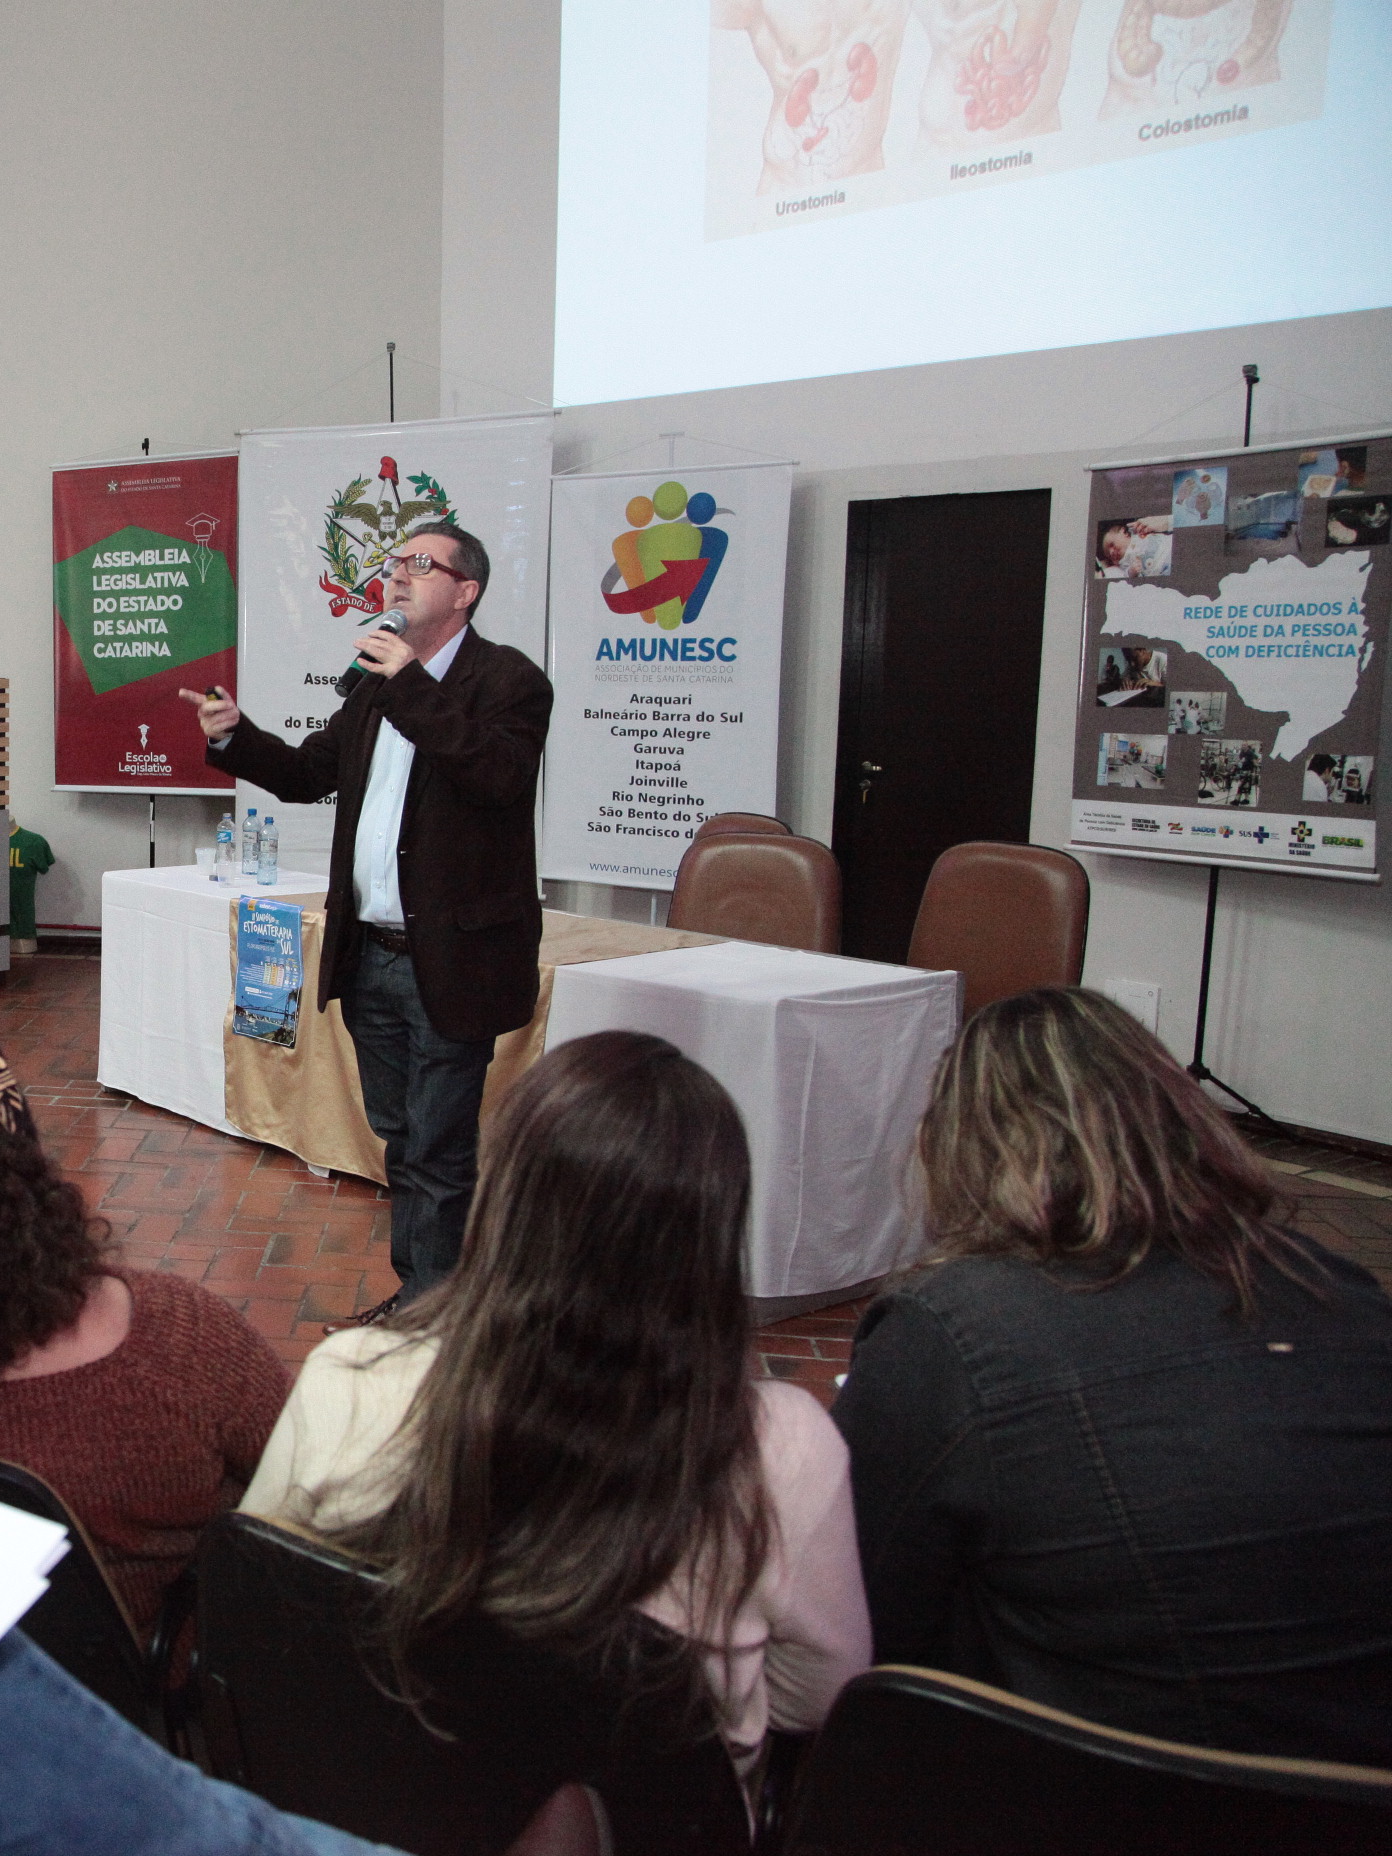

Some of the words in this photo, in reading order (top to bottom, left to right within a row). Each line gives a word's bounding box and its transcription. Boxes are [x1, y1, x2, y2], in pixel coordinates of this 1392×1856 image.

[1138, 104, 1249, 142] Colostomia
[950, 150, 1033, 180] Ileostomia
[775, 190, 846, 216] Urostomia
[92, 548, 191, 568] ASSEMBLEIA
[93, 572, 189, 591] LEGISLATIVA
[93, 597, 117, 614] DO
[120, 595, 182, 613] ESTADO
[332, 597, 362, 609] ESTADO
[364, 601, 374, 611] DE
[1183, 606, 1223, 619] REDE
[1227, 605, 1248, 618] DE
[1253, 602, 1342, 617] CUIDADOS
[1347, 597, 1358, 615] À
[93, 620, 114, 635] DE
[116, 618, 168, 635] SANTA
[1206, 621, 1258, 638] SAÚDE
[1263, 625, 1285, 638] DA
[1291, 623, 1357, 637] PESSOA
[93, 641, 171, 658] CATARINA
[595, 637, 737, 662] AMUNESC
[1205, 645, 1239, 658] COM
[1245, 640, 1356, 658] DEFICIÊNCIA
[595, 664, 648, 674] ASSOCIAÇÃO
[651, 665, 661, 673] DE
[665, 664, 716, 673] MUNICÍPIOS
[720, 665, 734, 674] DO
[595, 674, 639, 682] NORDESTE
[657, 675, 685, 683] SANTA
[630, 694, 692, 707] Araquari
[284, 717, 301, 729] do
[584, 709, 647, 721] Balneário
[652, 711, 690, 722] Barra
[696, 711, 715, 723] do
[720, 712, 743, 723] Sul
[610, 726, 658, 739] Campo
[662, 728, 711, 741] Alegre
[125, 752, 158, 762] Escola
[634, 744, 684, 755] Garuva
[118, 762, 171, 775] Legislativo
[635, 759, 681, 773] Itapoá
[629, 776, 688, 788] Joinville
[612, 791, 633, 802] Rio
[638, 792, 704, 806] Negrinho
[599, 806, 623, 817] São
[628, 808, 668, 820] Bento
[673, 811, 691, 822] do
[587, 822, 611, 833] São
[615, 824, 679, 838] Francisco
[685, 828, 697, 839] d
[9, 848, 24, 867] IL
[589, 862, 678, 877] www.amunesc
[243, 921, 292, 940] ESTOMATERAPIA
[281, 938, 294, 955] SUL
